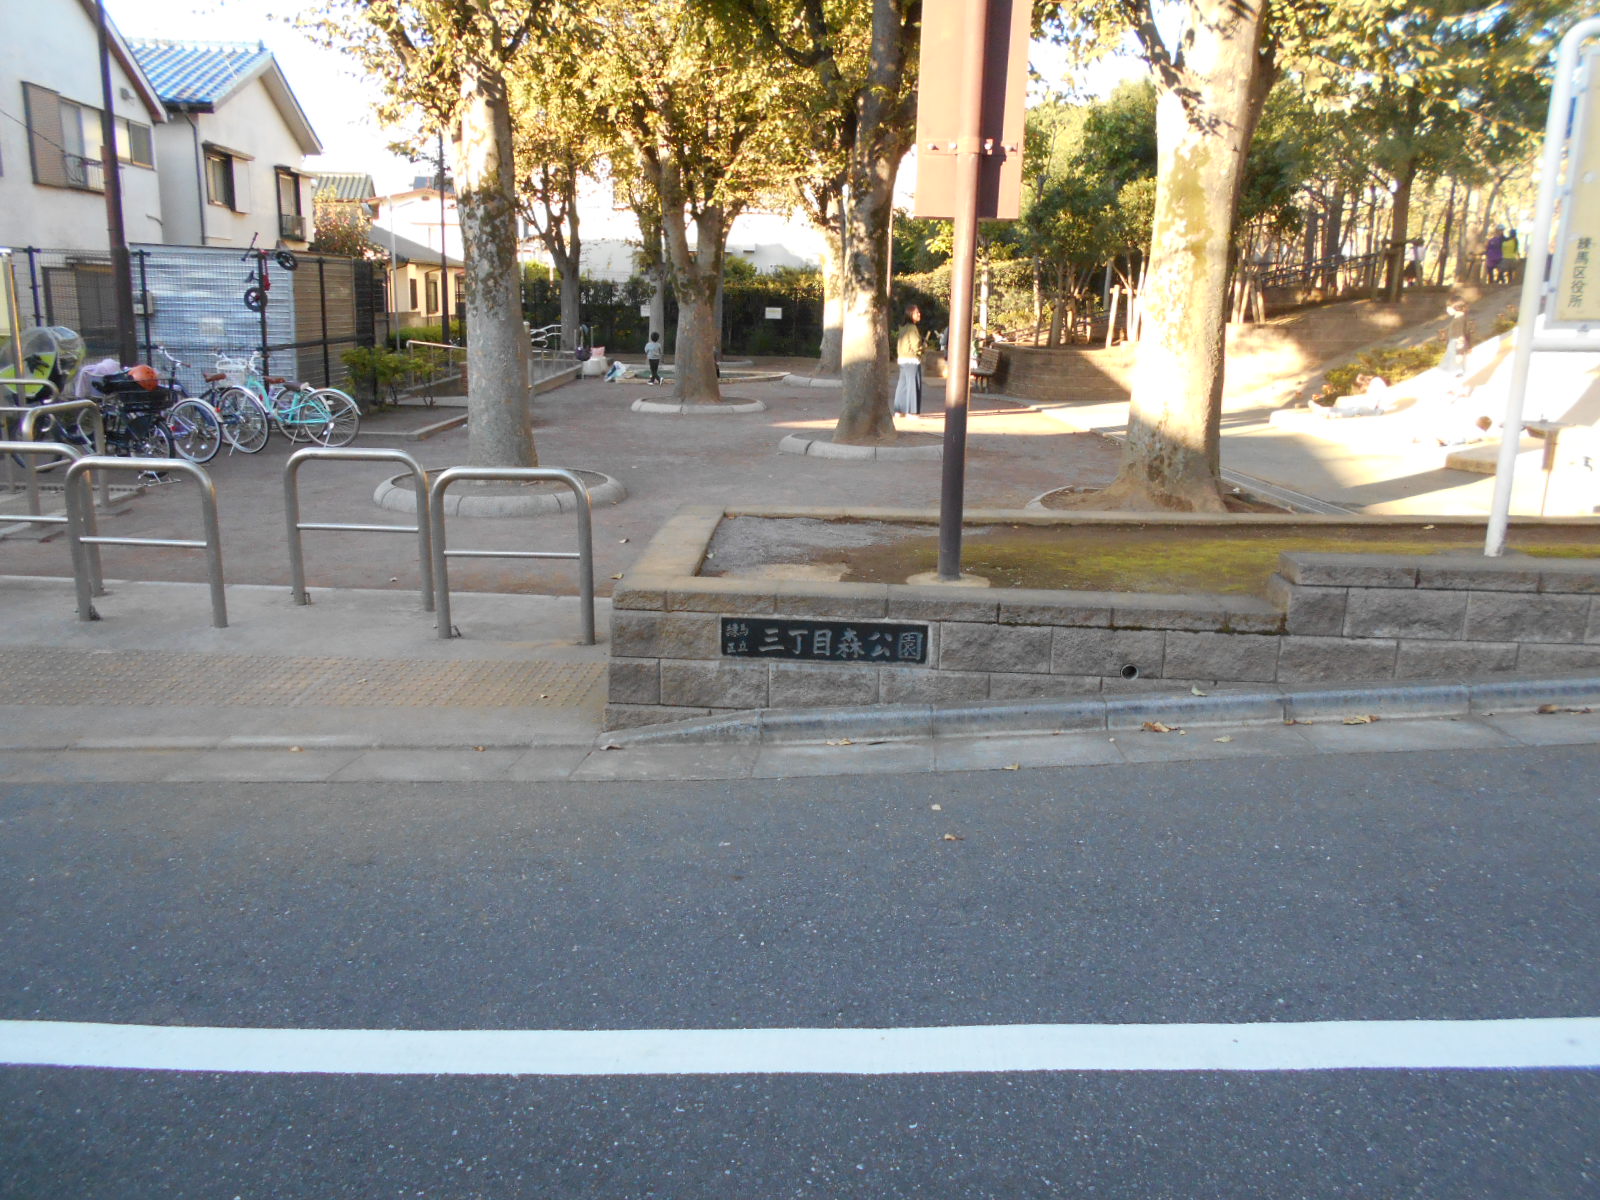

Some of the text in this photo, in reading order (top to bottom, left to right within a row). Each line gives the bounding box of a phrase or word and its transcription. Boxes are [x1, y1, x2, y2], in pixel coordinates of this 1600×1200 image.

[1568, 237, 1592, 308] 練馬区役所
[758, 628, 923, 660] 三丁目森公園
